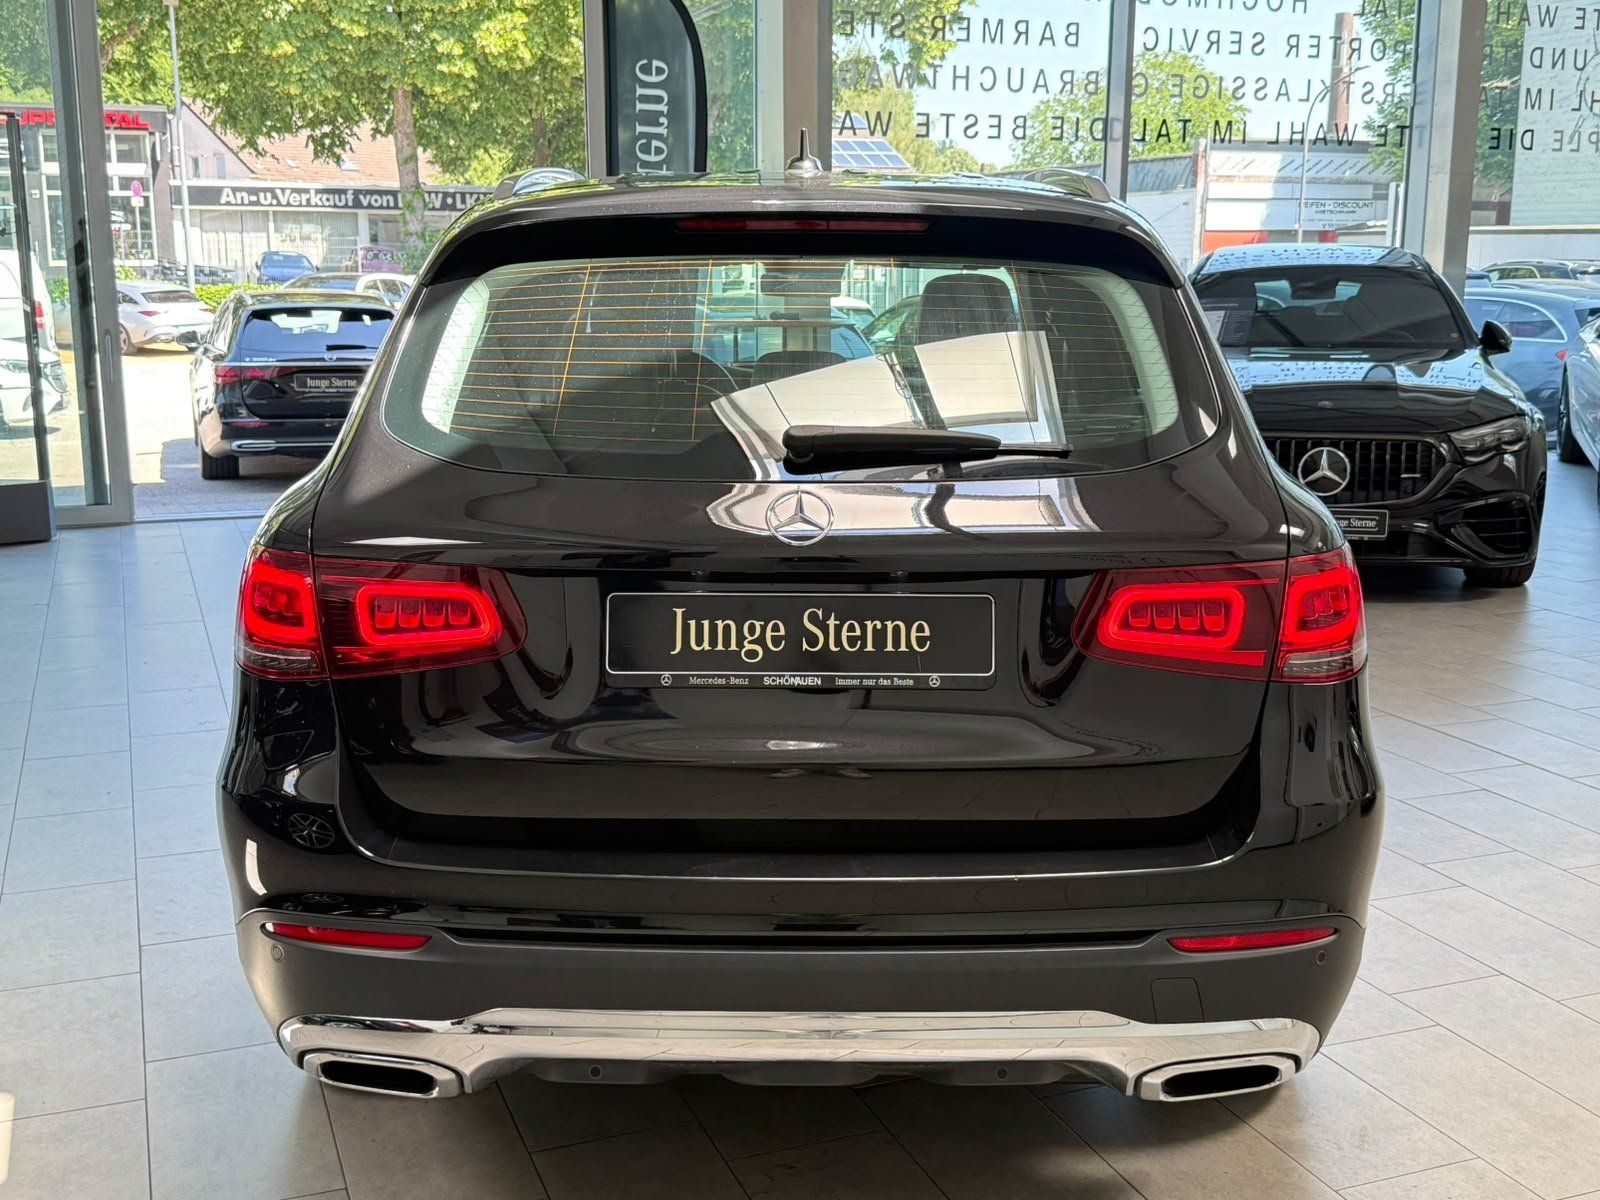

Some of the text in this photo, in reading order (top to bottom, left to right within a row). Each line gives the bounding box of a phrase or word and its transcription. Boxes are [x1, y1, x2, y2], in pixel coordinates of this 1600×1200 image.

[361, 192, 394, 208] von
[306, 377, 357, 389] Junge Sterne
[1350, 518, 1376, 527] Sterne
[670, 607, 931, 662] Junge Sterne
[688, 676, 750, 685] Mercedes-Benz
[835, 677, 860, 686] Immer
[862, 678, 877, 686] nur
[878, 677, 891, 686] das
[893, 677, 914, 686] Beste
